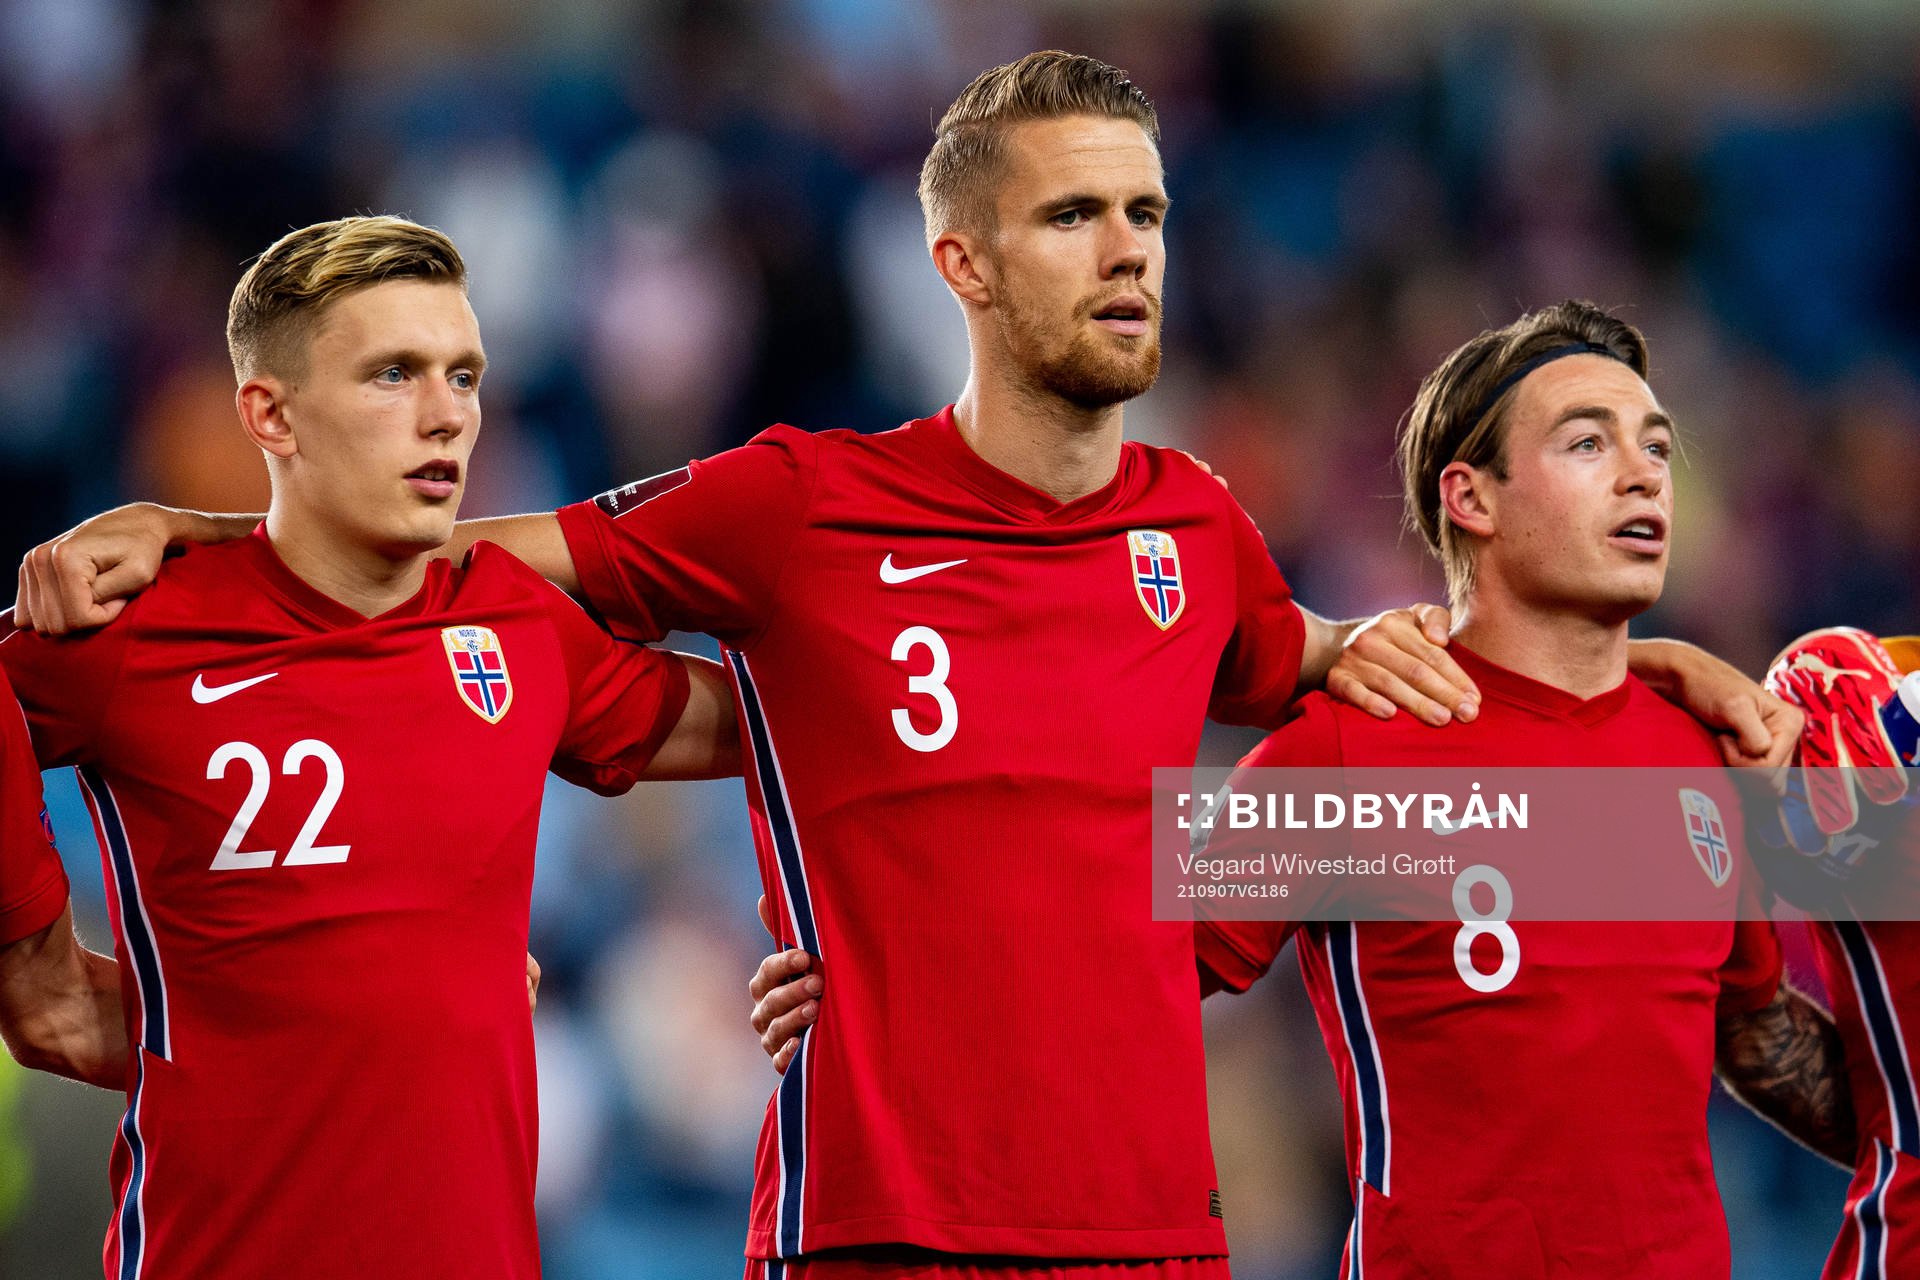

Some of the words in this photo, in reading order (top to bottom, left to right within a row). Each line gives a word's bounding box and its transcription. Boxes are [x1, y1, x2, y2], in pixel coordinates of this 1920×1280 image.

[890, 625, 959, 752] 3
[206, 738, 352, 871] 22
[1451, 863, 1521, 993] 8
